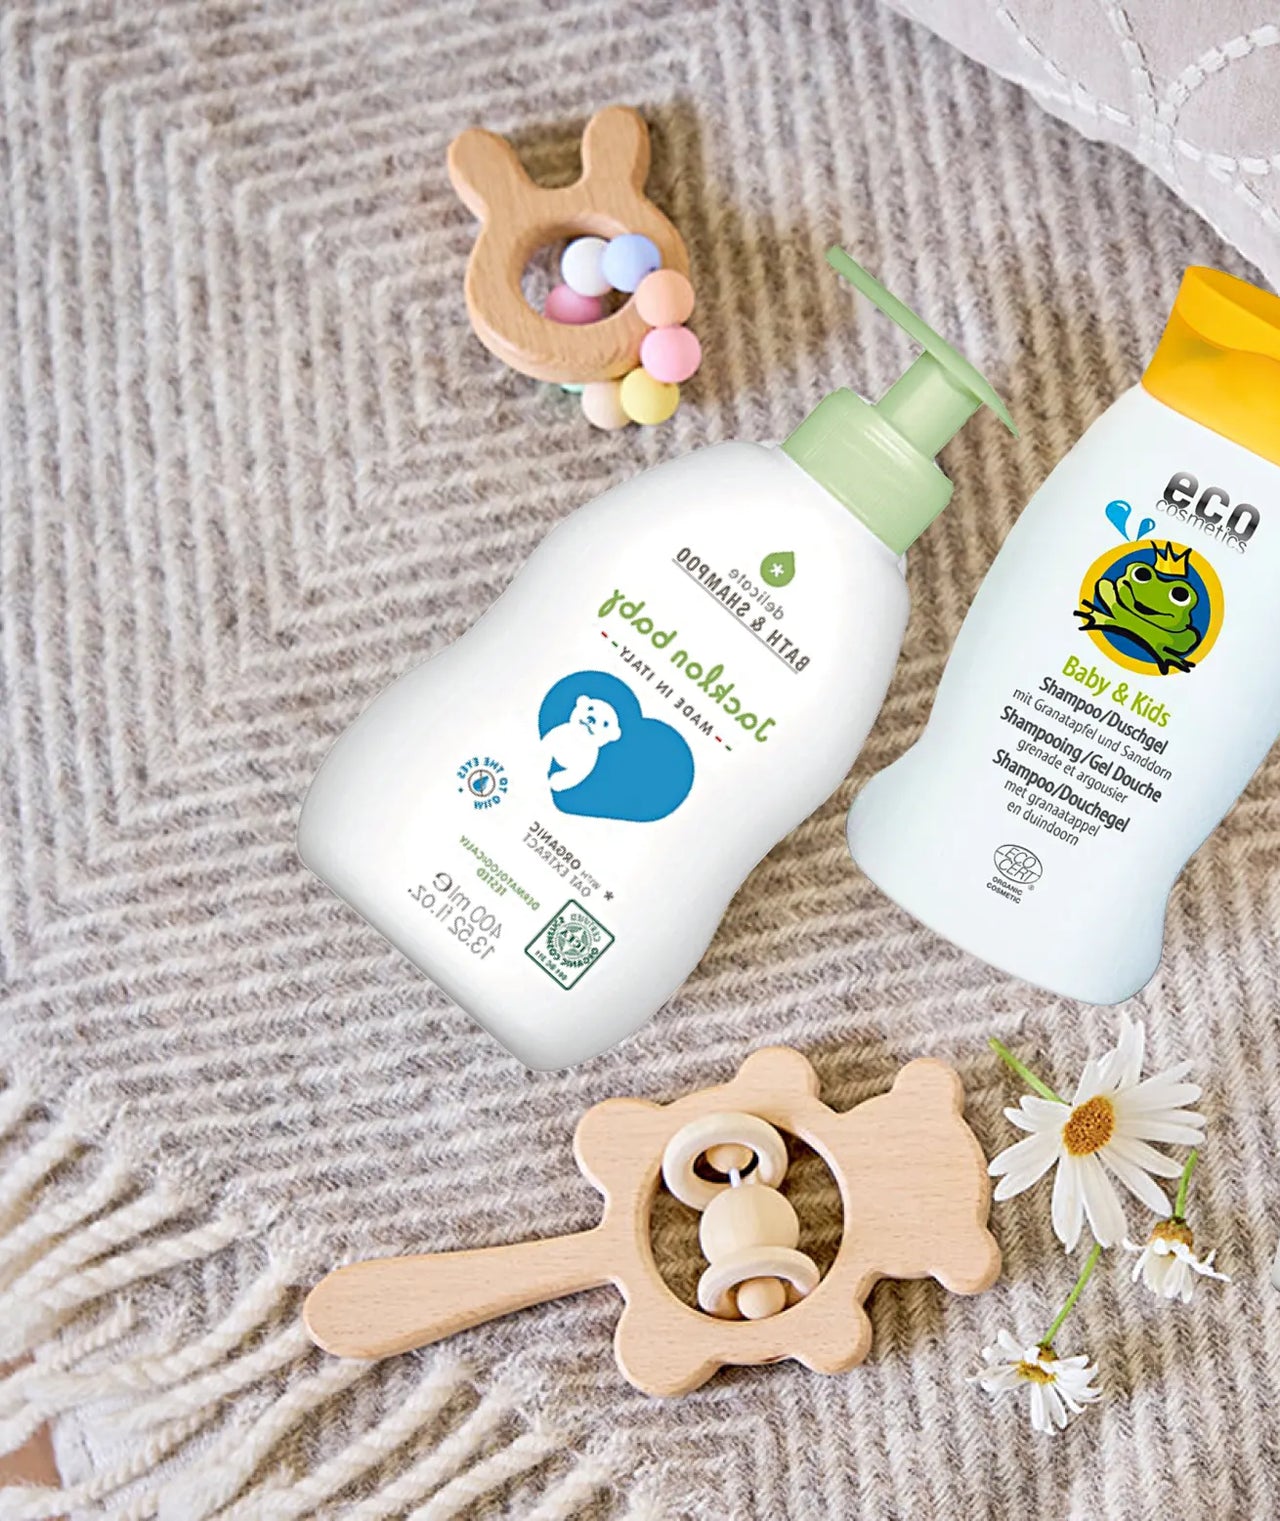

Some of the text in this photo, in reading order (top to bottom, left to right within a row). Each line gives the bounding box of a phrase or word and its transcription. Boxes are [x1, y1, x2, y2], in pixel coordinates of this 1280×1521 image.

[1155, 492, 1250, 553] cosmetics
[1162, 471, 1261, 545] eco
[1038, 676, 1170, 756] Shampoo/Duschgel
[1061, 655, 1171, 728] Baby & Kids
[1012, 688, 1173, 781] mit Granatapfel und Sanddorn
[991, 748, 1131, 833] Shampoo/Douchegel
[1015, 738, 1129, 804] grenade et argousier
[1111, 765, 1163, 803] Douche
[1003, 779, 1101, 838] met granaatappel
[1006, 801, 1080, 847] en duindoorn
[986, 882, 1021, 905] COSMETIC
[992, 875, 1023, 896] ORGANIC
